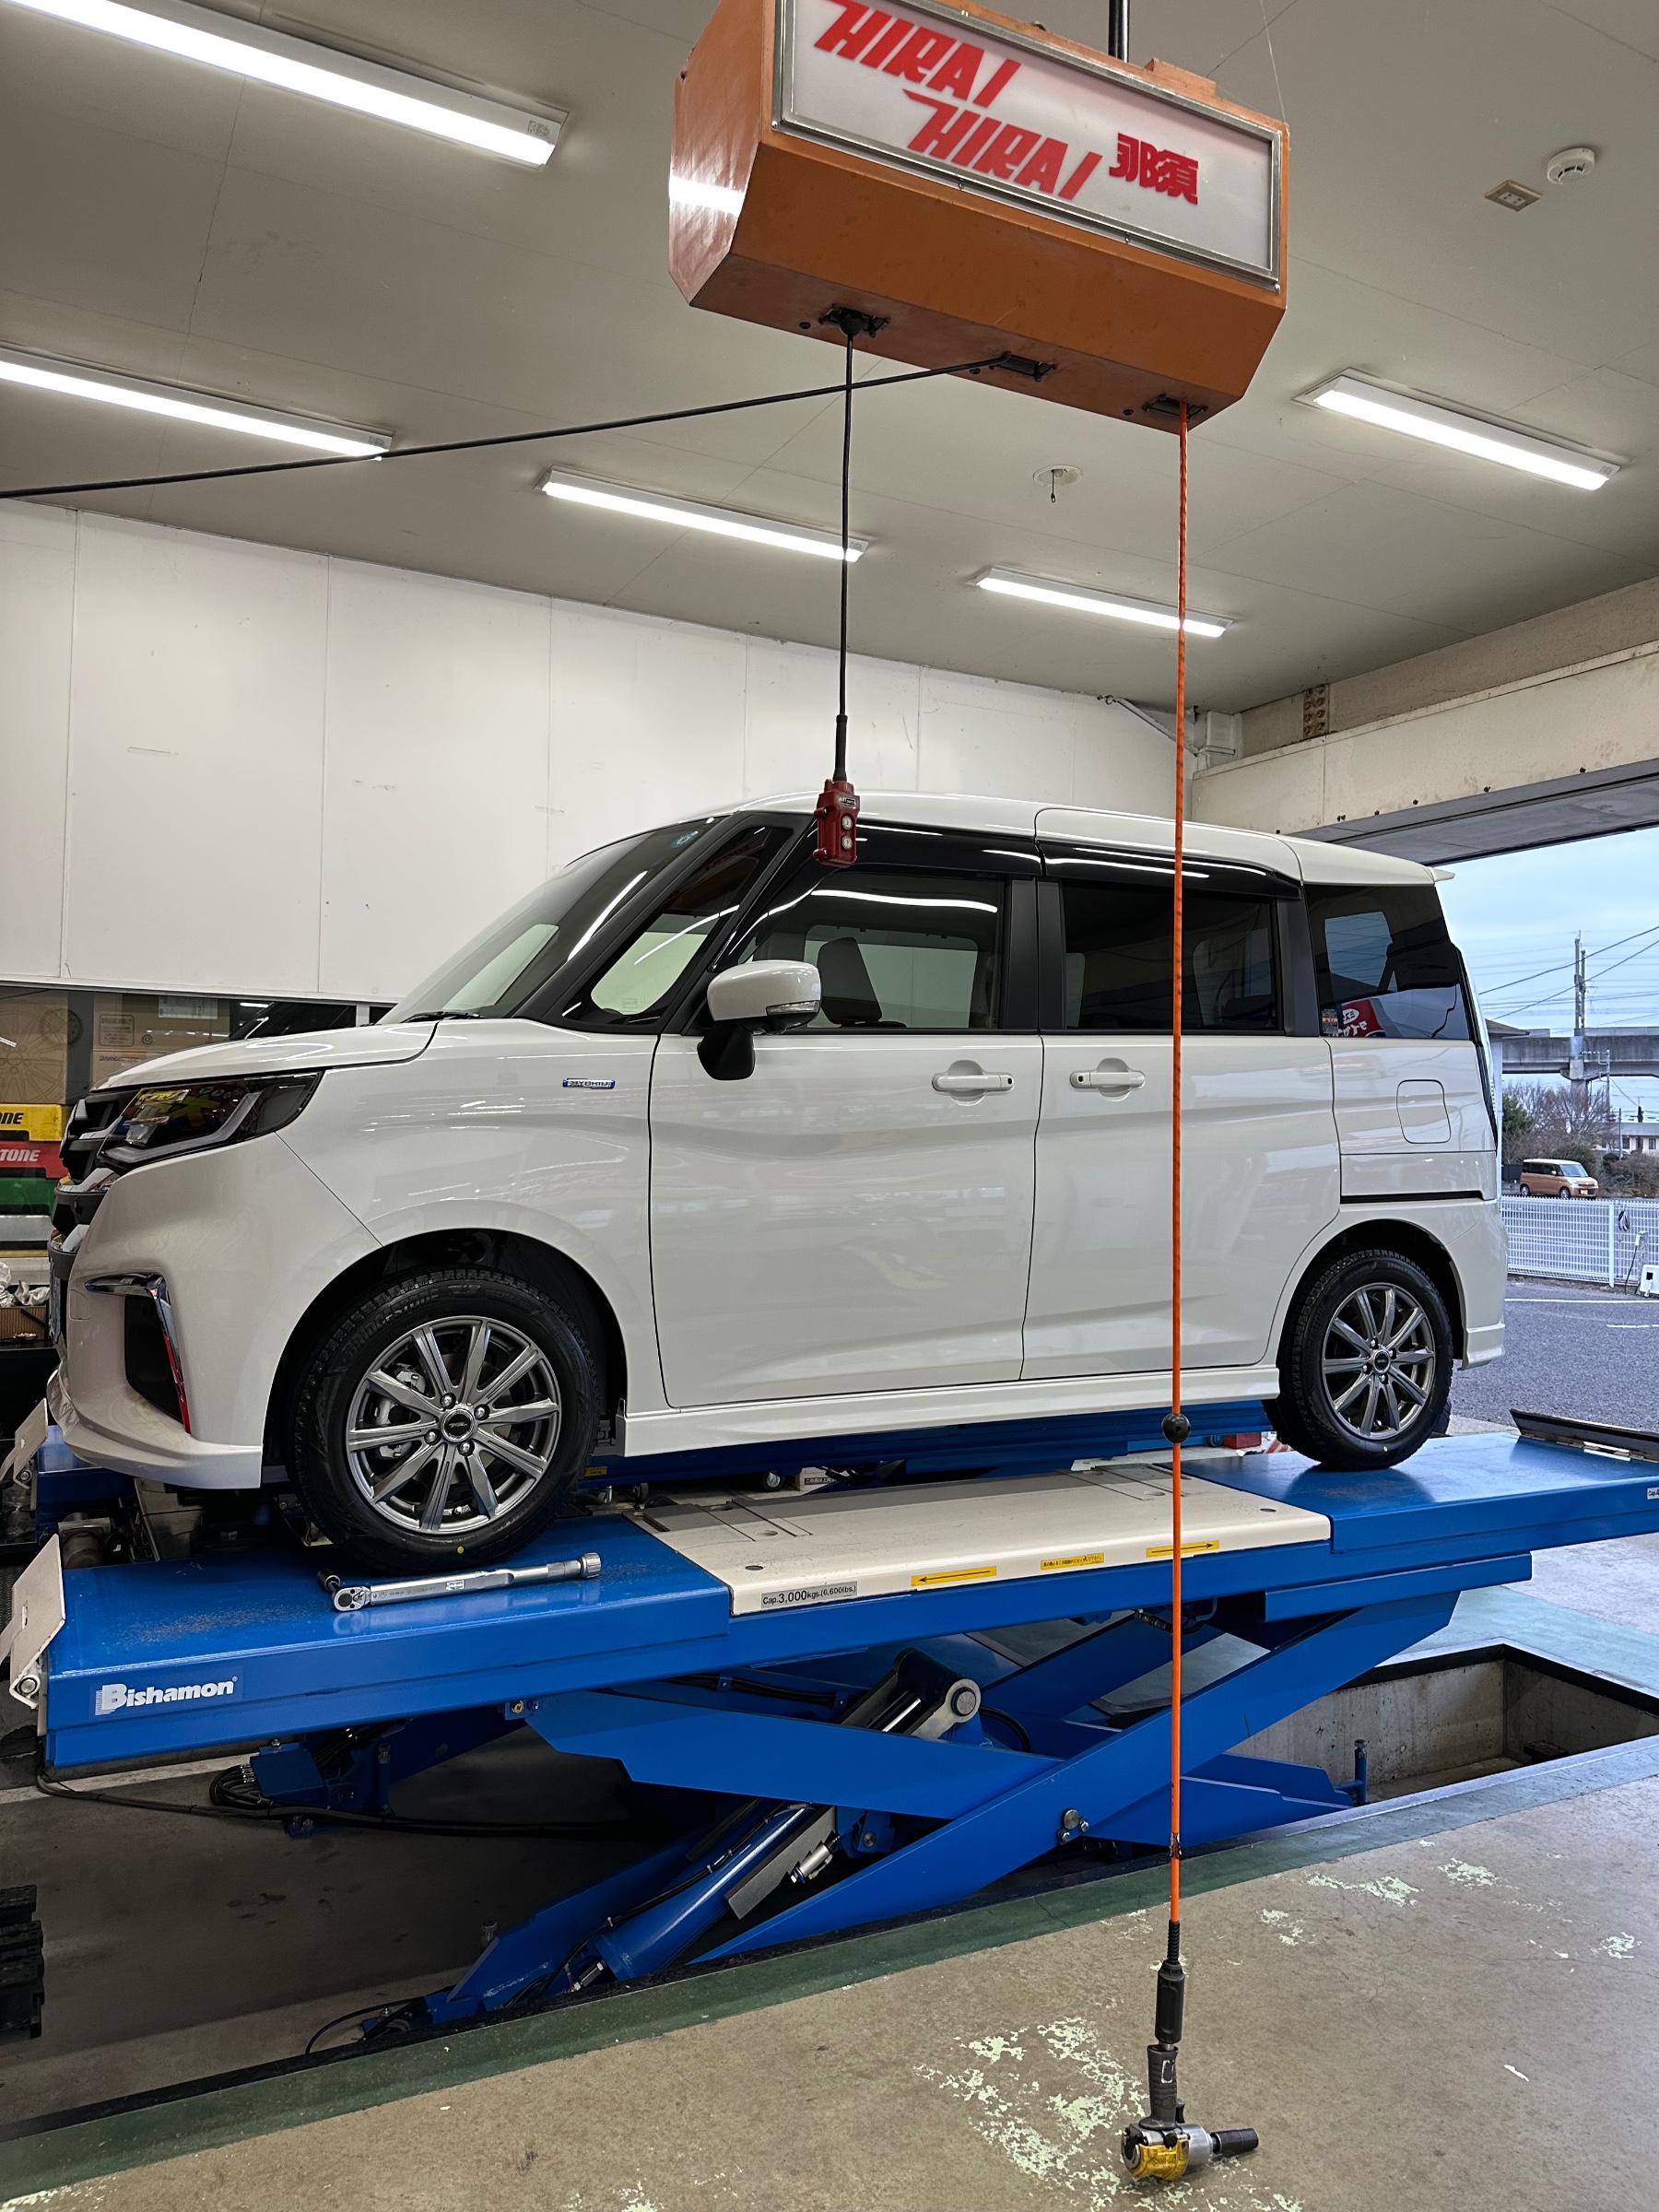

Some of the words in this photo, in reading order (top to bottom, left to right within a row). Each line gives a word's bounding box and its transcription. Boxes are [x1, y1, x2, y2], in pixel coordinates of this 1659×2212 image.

[814, 0, 1021, 108] HIRAI
[902, 88, 1103, 200] HIRAI
[0, 1112, 24, 1124] NE
[95, 1680, 234, 1716] Bishamon
